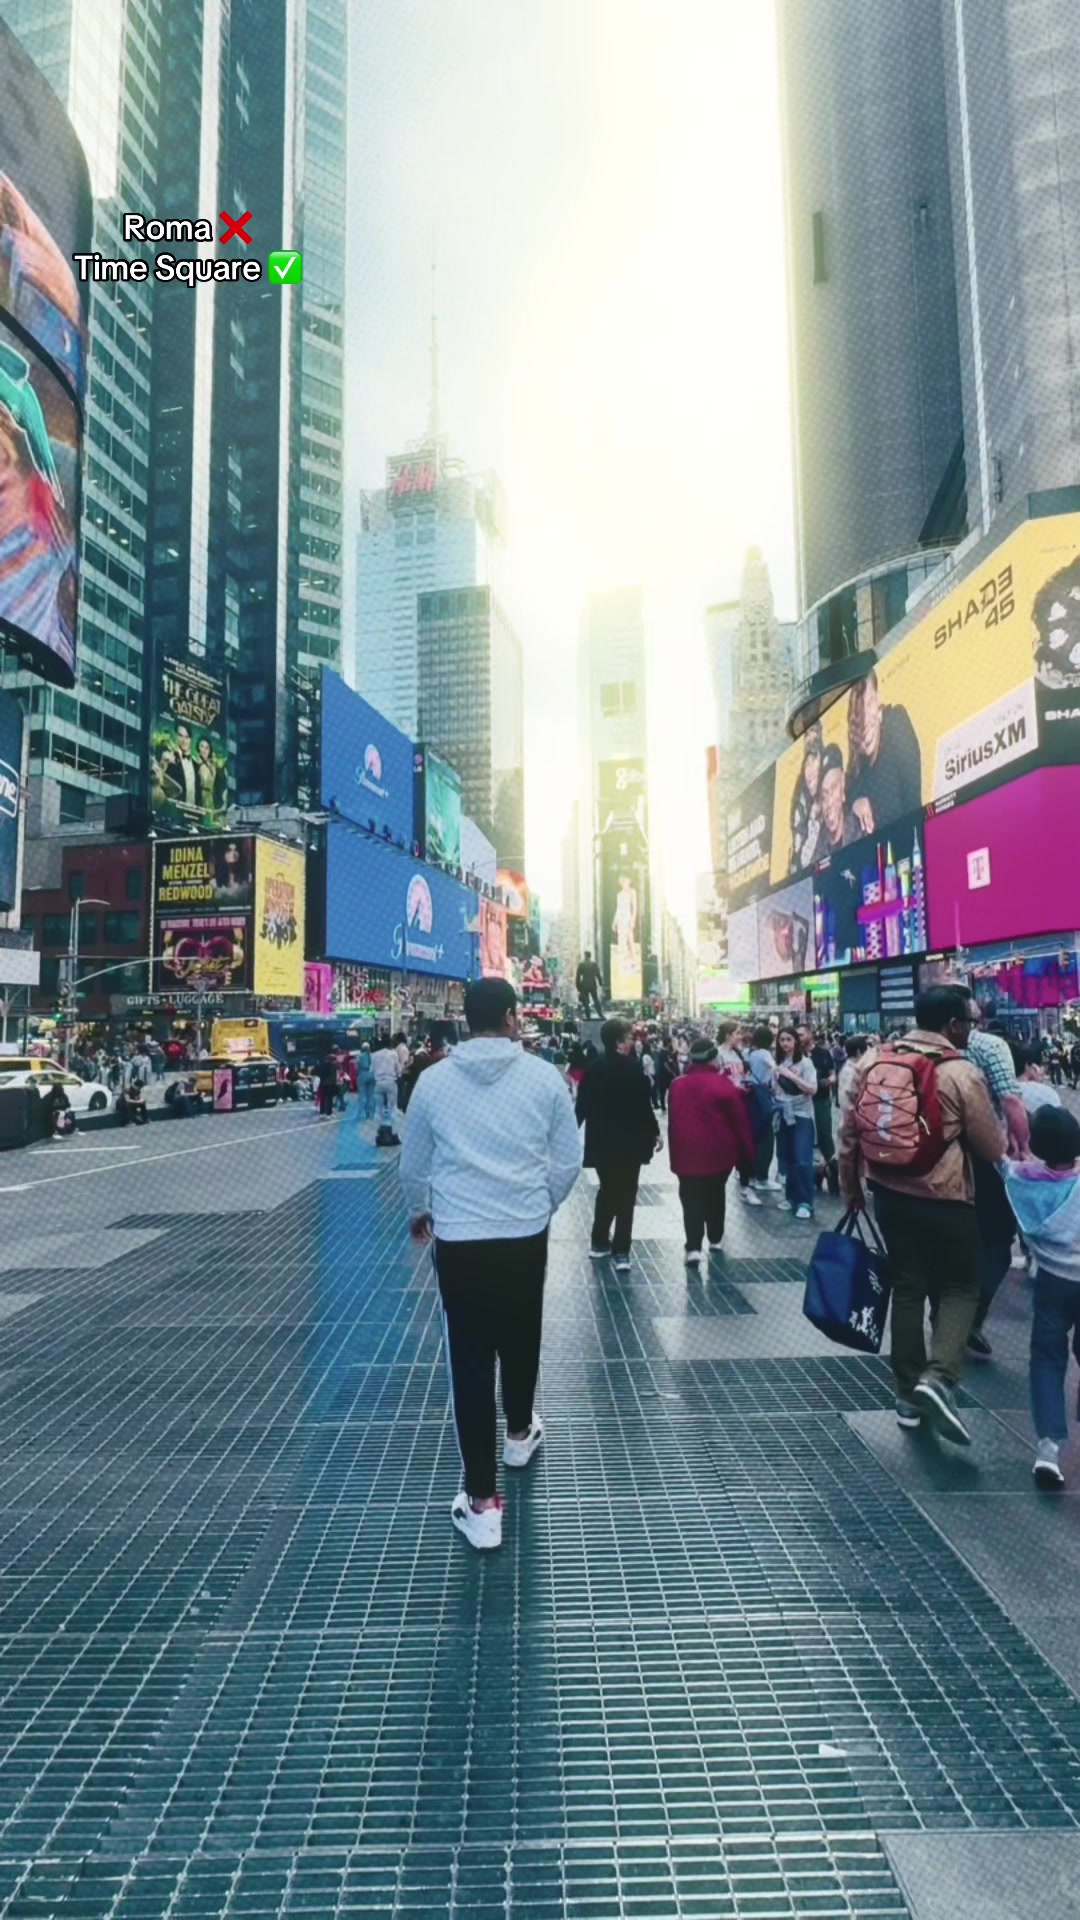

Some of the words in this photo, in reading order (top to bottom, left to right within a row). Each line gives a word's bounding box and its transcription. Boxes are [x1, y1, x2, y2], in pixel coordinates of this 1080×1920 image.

[984, 591, 1015, 630] 45
[944, 716, 1026, 781] SiriusXM
[170, 847, 204, 863] IDINA
[162, 862, 210, 880] MENZEL
[158, 884, 214, 901] REDWOOD
[126, 995, 161, 1006] GIFTS
[168, 993, 224, 1005] LUGGAGE
